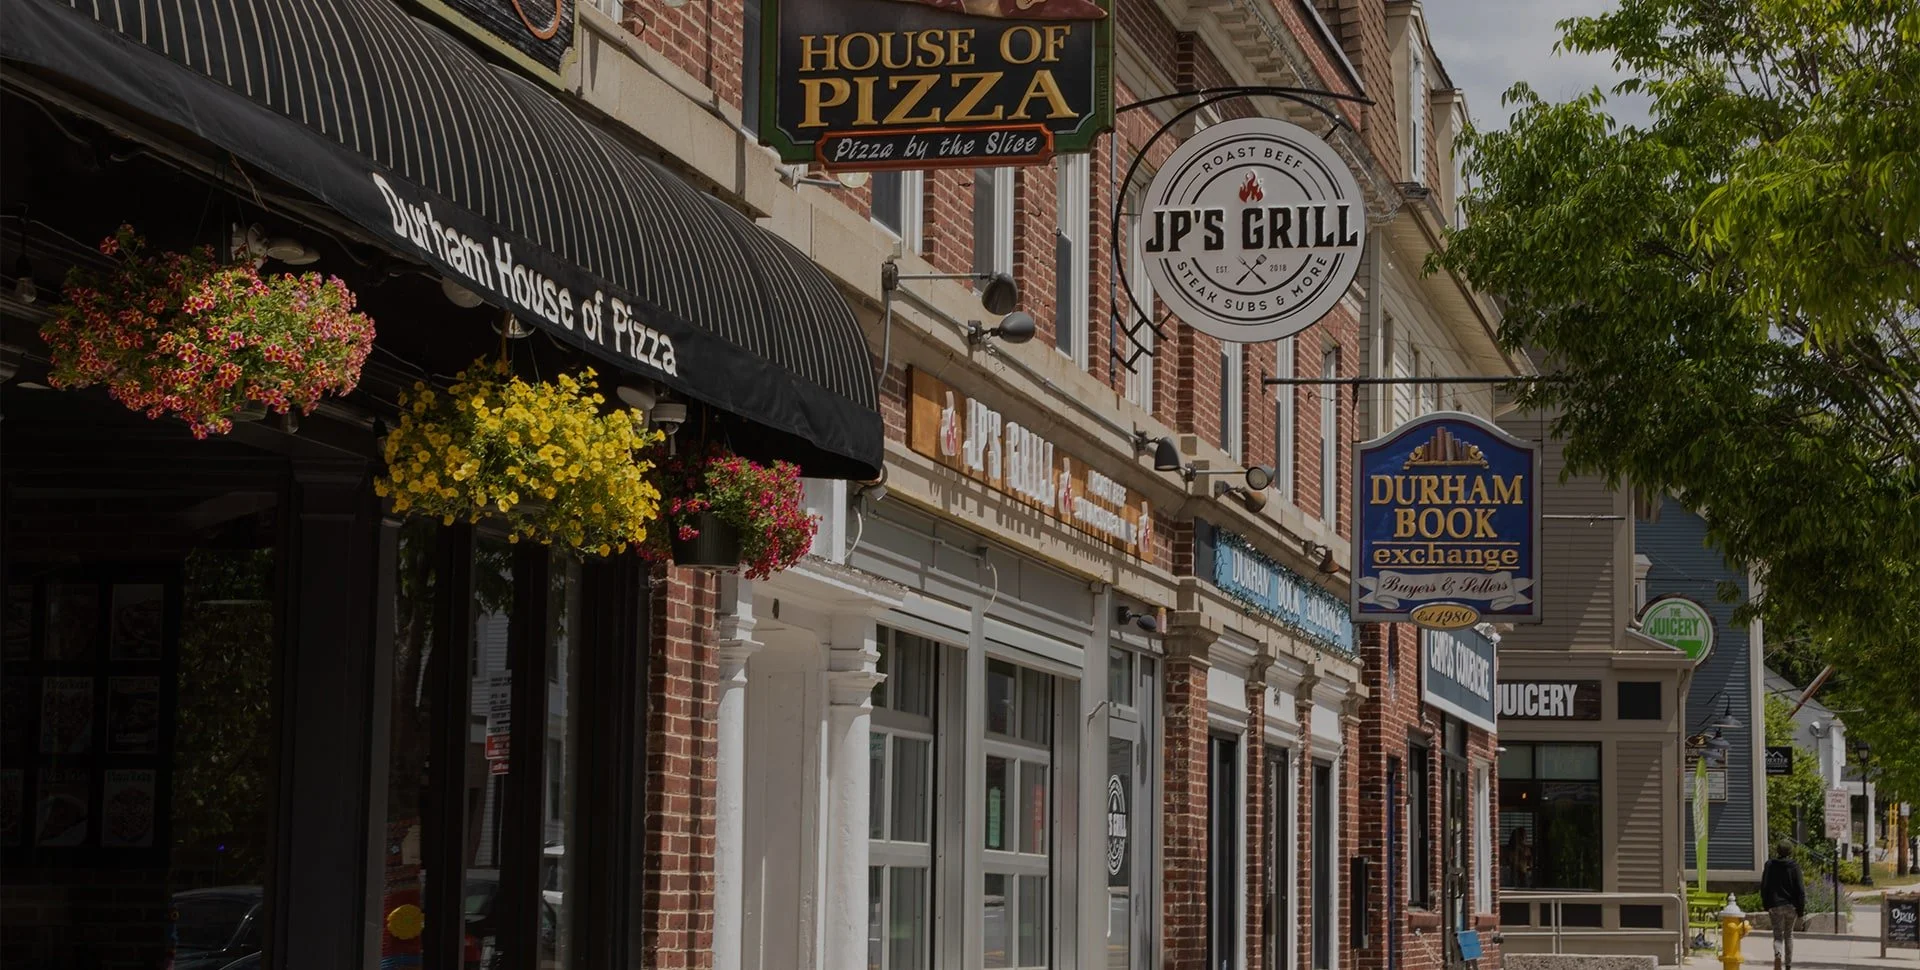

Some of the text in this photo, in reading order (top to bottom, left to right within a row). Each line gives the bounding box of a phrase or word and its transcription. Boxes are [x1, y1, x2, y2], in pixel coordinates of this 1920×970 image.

[798, 24, 1072, 72] HOUSE OF
[798, 69, 1080, 128] PIZZA
[834, 131, 1037, 162] Pizza by the Slice
[1202, 146, 1304, 173] ROAST BEEF
[1145, 205, 1358, 253] JP'S GRILL
[372, 172, 679, 378] Durham House of Pizza
[1270, 264, 1287, 272] 2018
[1177, 256, 1327, 312] STEAK SUBS & MORE
[1005, 421, 1055, 508] GRILL
[1370, 475, 1524, 505] DURHAM
[1393, 508, 1498, 539] BOOK
[1372, 543, 1520, 571] exchange
[1381, 576, 1508, 598] Buyers & Sellers
[1435, 607, 1472, 626] 1980
[1650, 618, 1701, 637] JUICERY
[1669, 608, 1681, 617] THE
